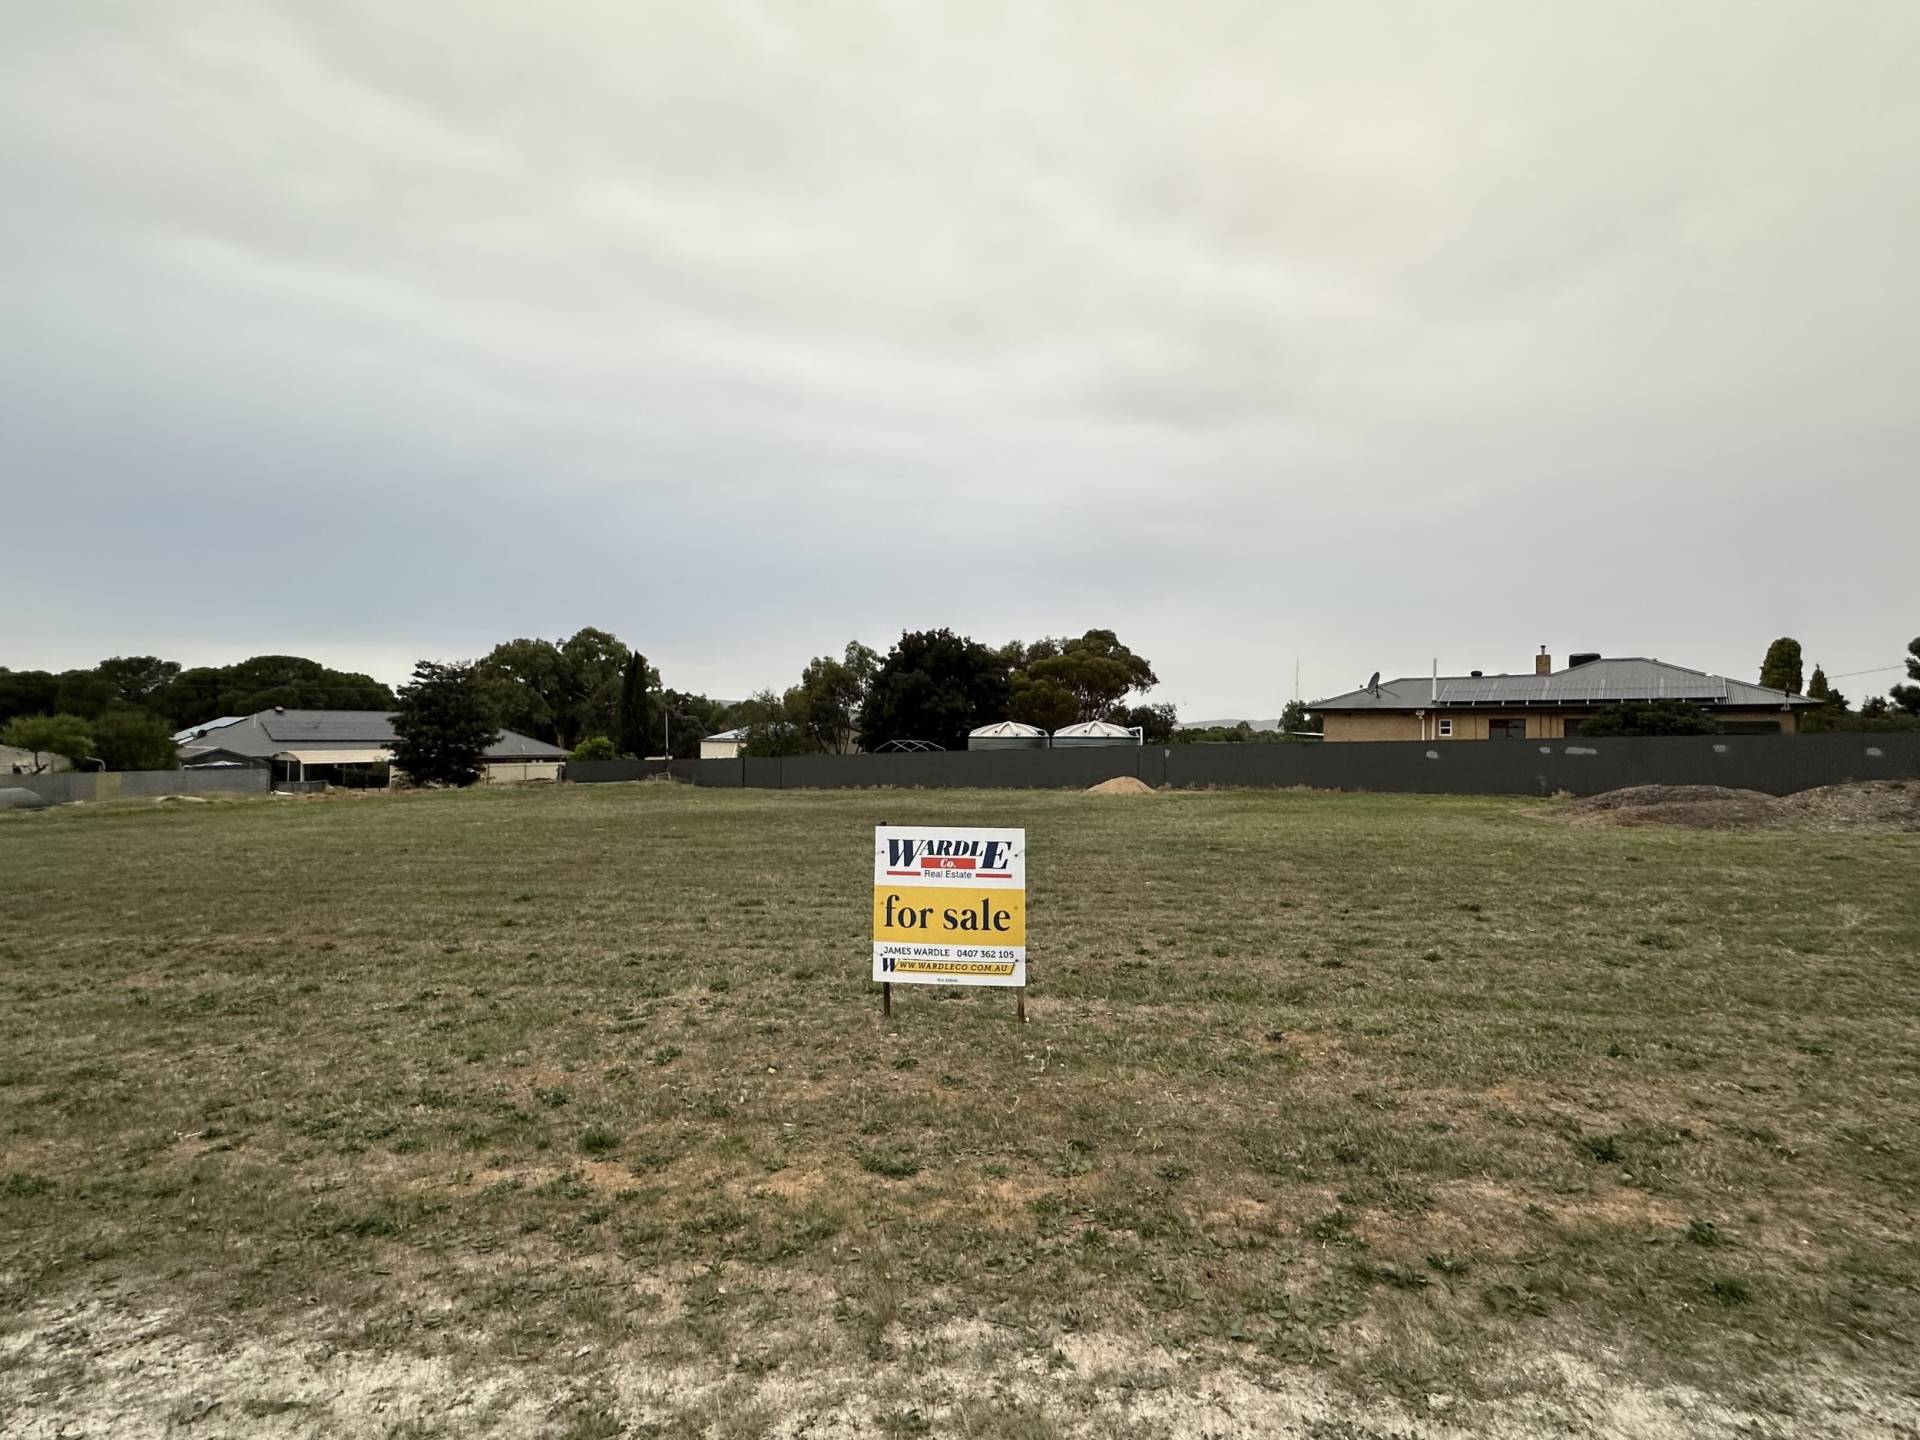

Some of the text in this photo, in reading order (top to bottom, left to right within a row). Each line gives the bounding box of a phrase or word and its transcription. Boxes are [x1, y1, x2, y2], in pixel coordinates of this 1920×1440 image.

[887, 838, 1013, 870] WARDLE
[939, 858, 957, 869] Co.
[924, 870, 972, 879] Real Estate
[884, 894, 1011, 932] for sale
[883, 946, 1015, 959] JAMES WARDLE 0407 362 105
